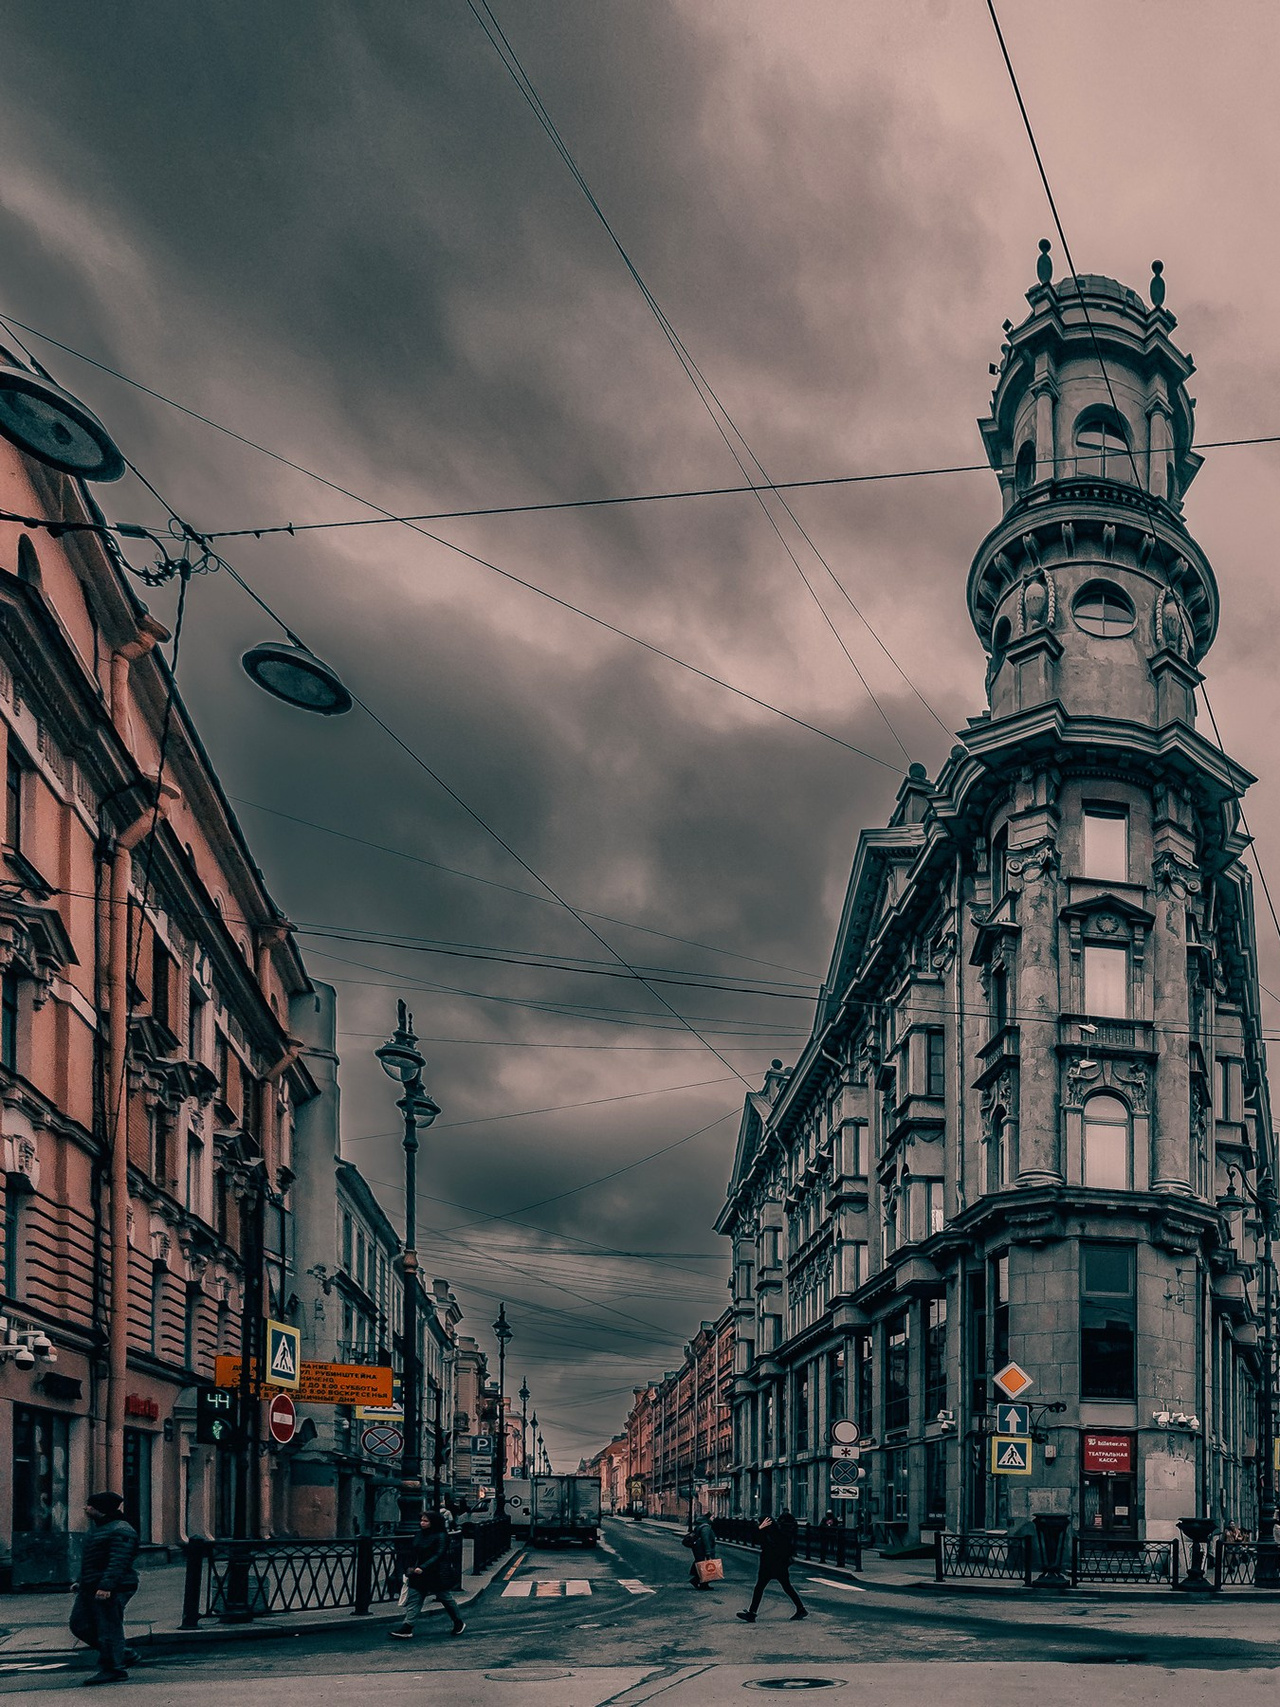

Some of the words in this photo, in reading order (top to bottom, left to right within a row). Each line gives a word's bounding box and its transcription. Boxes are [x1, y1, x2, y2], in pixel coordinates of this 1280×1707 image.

[315, 1370, 377, 1380] РУБИНШТЕЙНА
[340, 1384, 378, 1392] СУББОТЫ
[327, 1389, 388, 1398] ВОСКРЕСЕНЬЯ
[207, 1393, 229, 1409] 44
